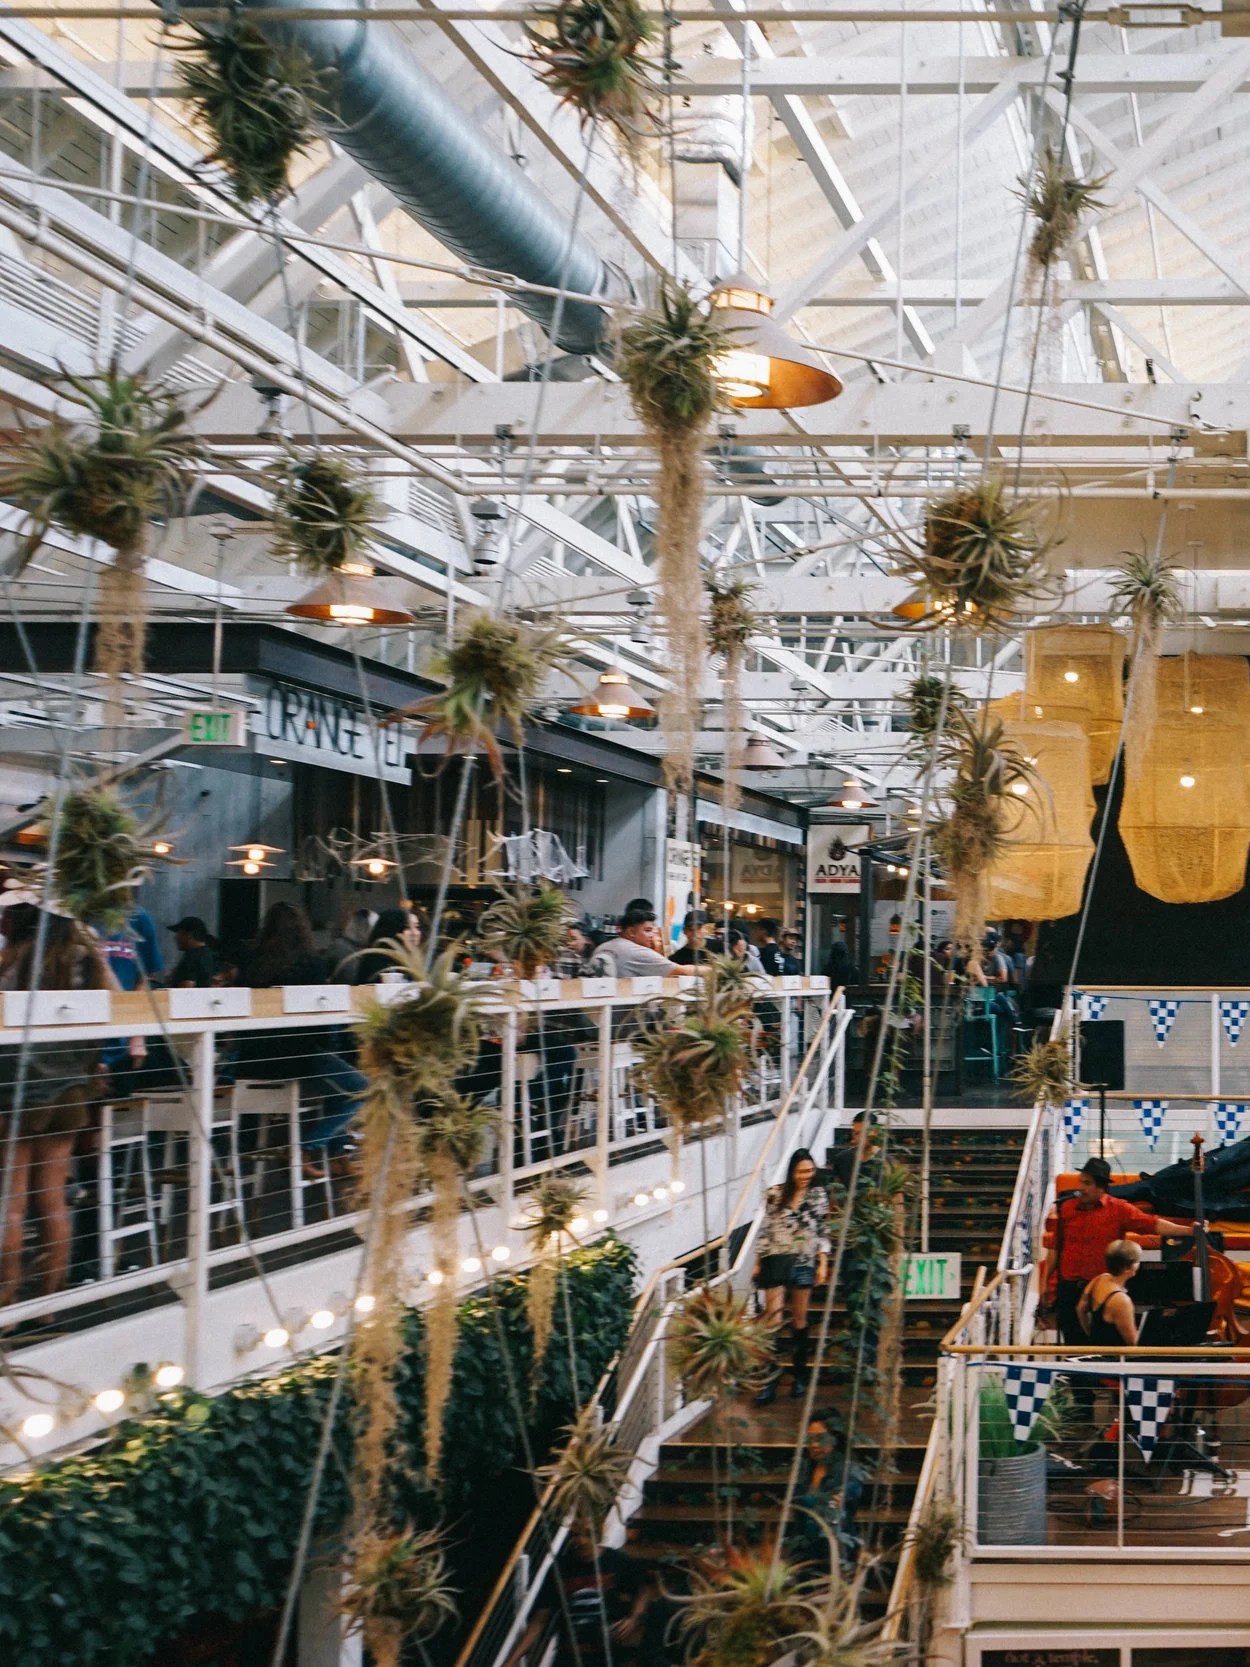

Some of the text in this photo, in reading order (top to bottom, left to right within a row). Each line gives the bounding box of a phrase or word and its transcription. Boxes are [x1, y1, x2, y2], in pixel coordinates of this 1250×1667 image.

[191, 713, 230, 742] EXIT
[266, 686, 364, 759] ORANGE
[815, 864, 860, 876] ADYA
[900, 1259, 948, 1295] EXIT
